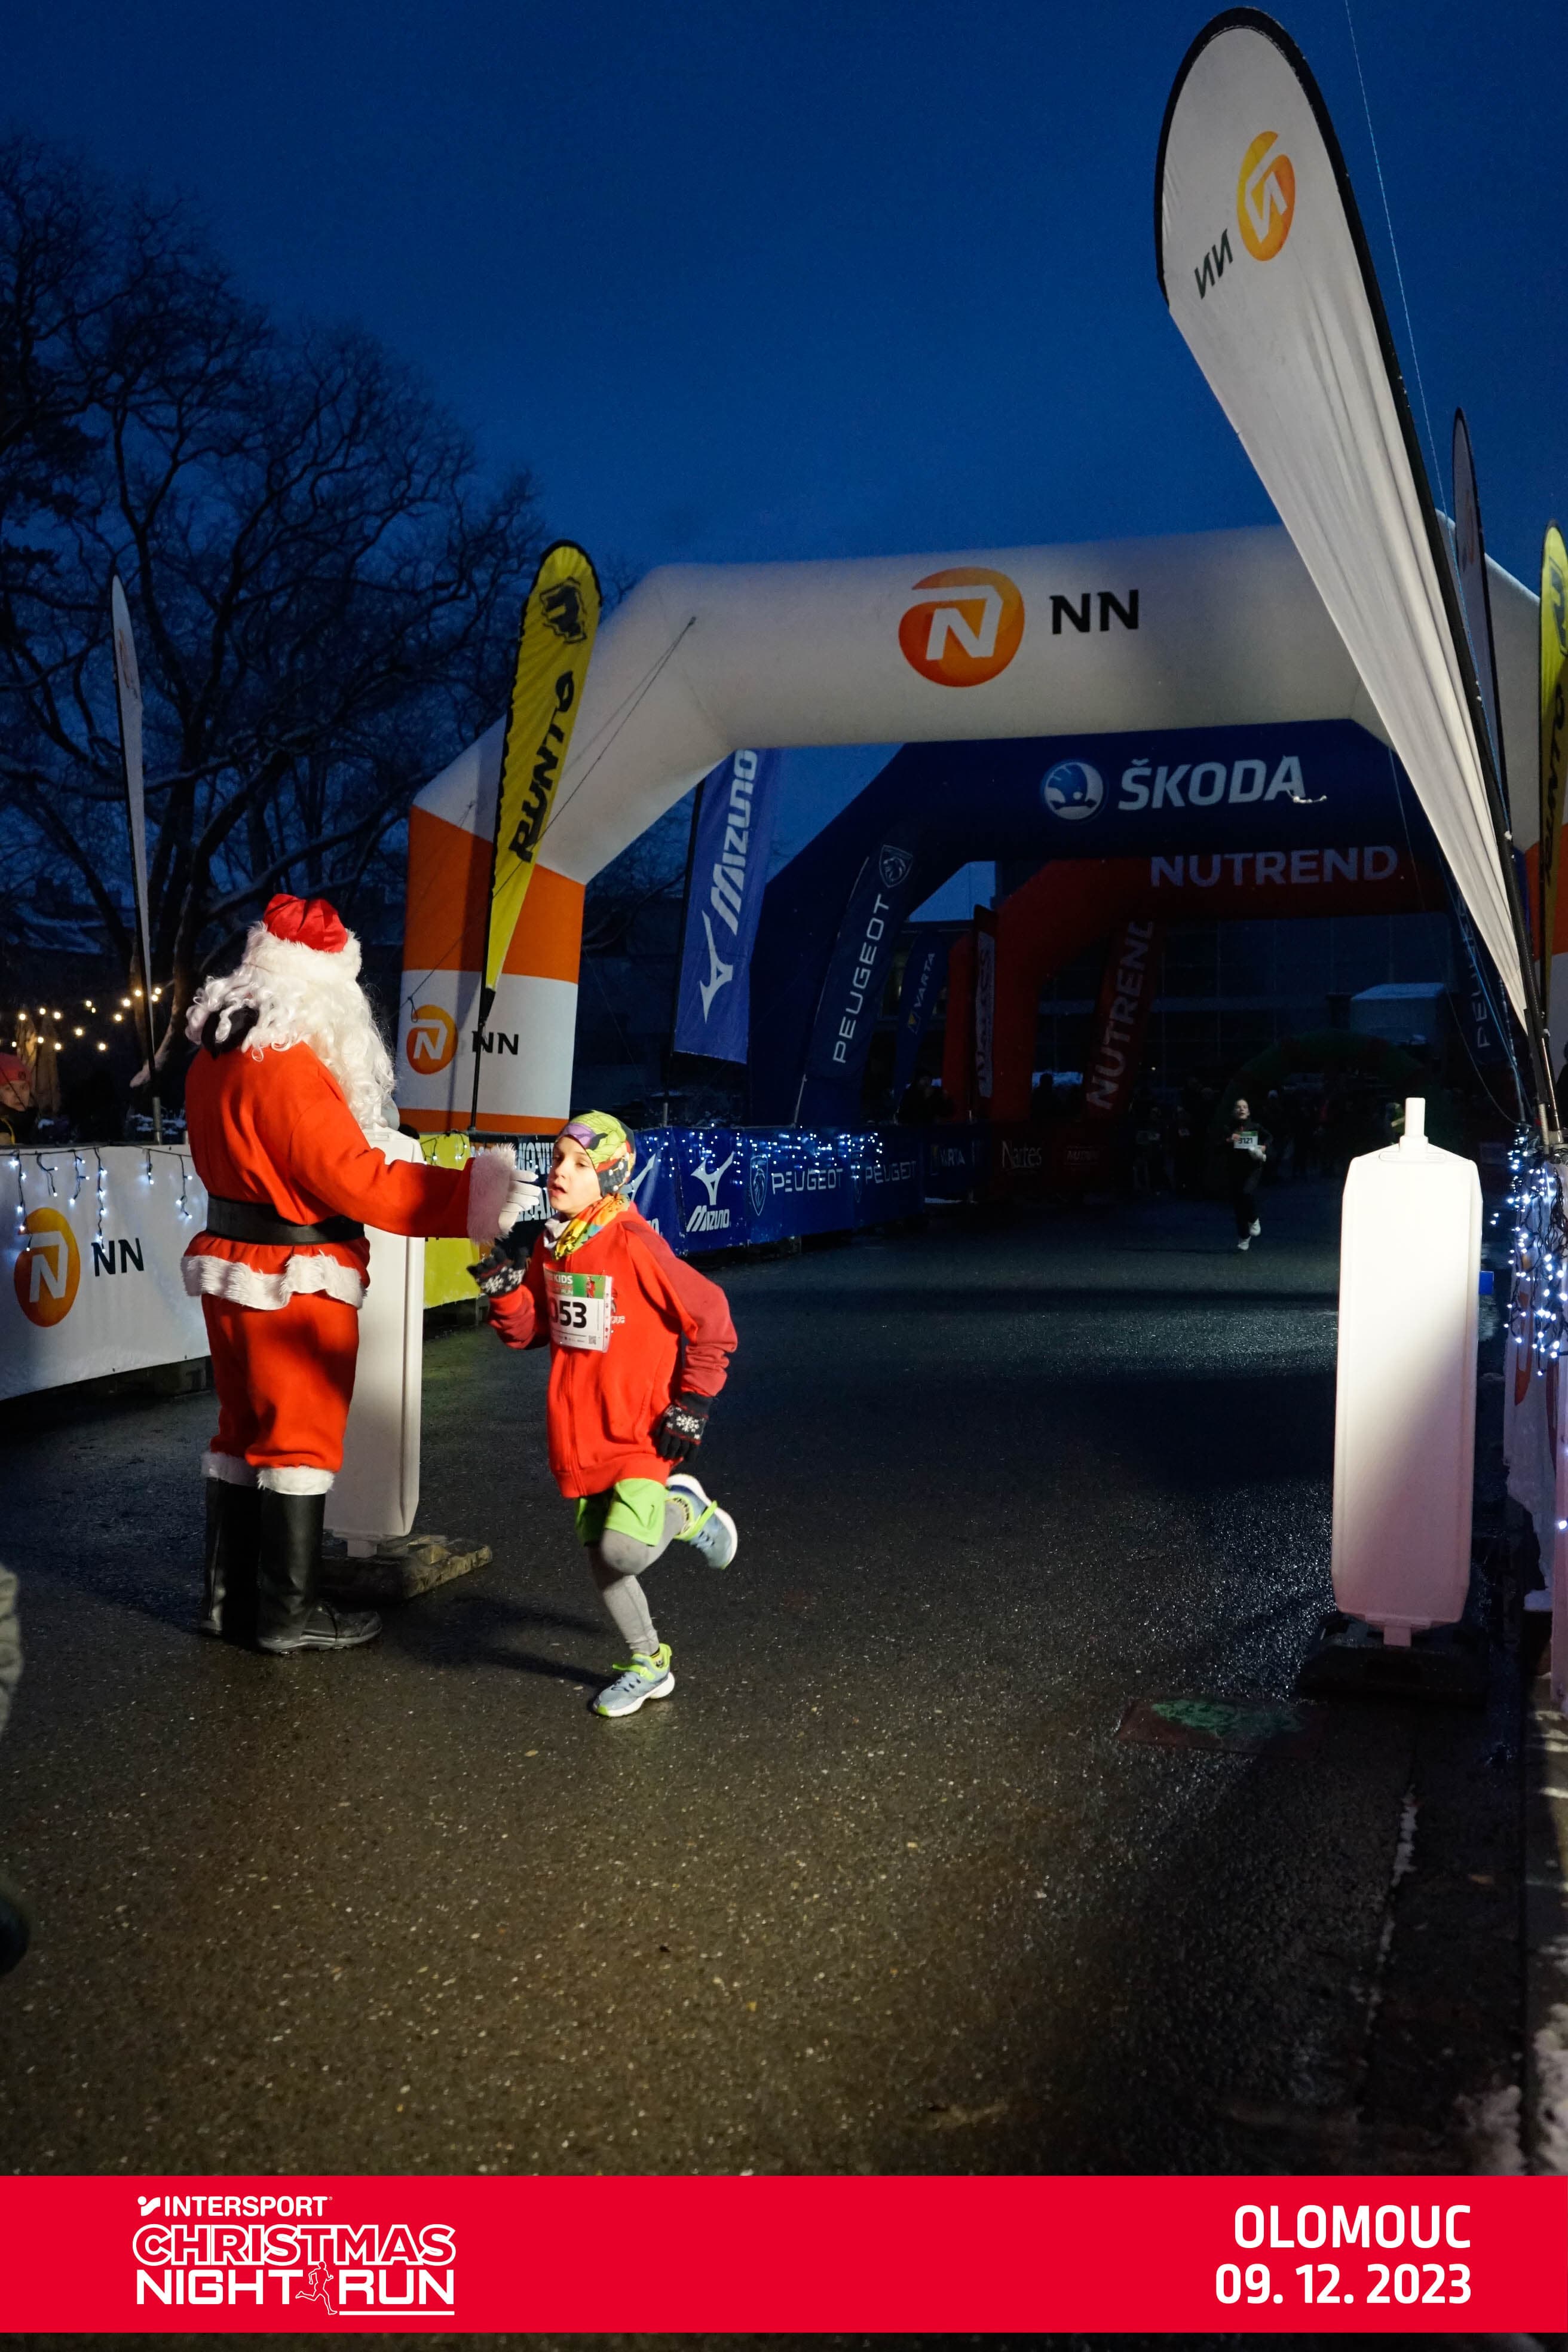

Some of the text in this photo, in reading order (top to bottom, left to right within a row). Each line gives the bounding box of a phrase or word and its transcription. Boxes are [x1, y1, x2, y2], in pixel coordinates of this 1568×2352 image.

[1049, 589, 1139, 635] NN
[509, 669, 575, 862] RUNTO
[1117, 755, 1306, 811] ŠKODA
[1150, 844, 1399, 889] NUTREND
[832, 893, 890, 1064] PEUGEOT
[912, 952, 936, 1008] VARTA
[771, 1168, 843, 1195] PEUGEOT
[91, 1238, 144, 1277] NN
